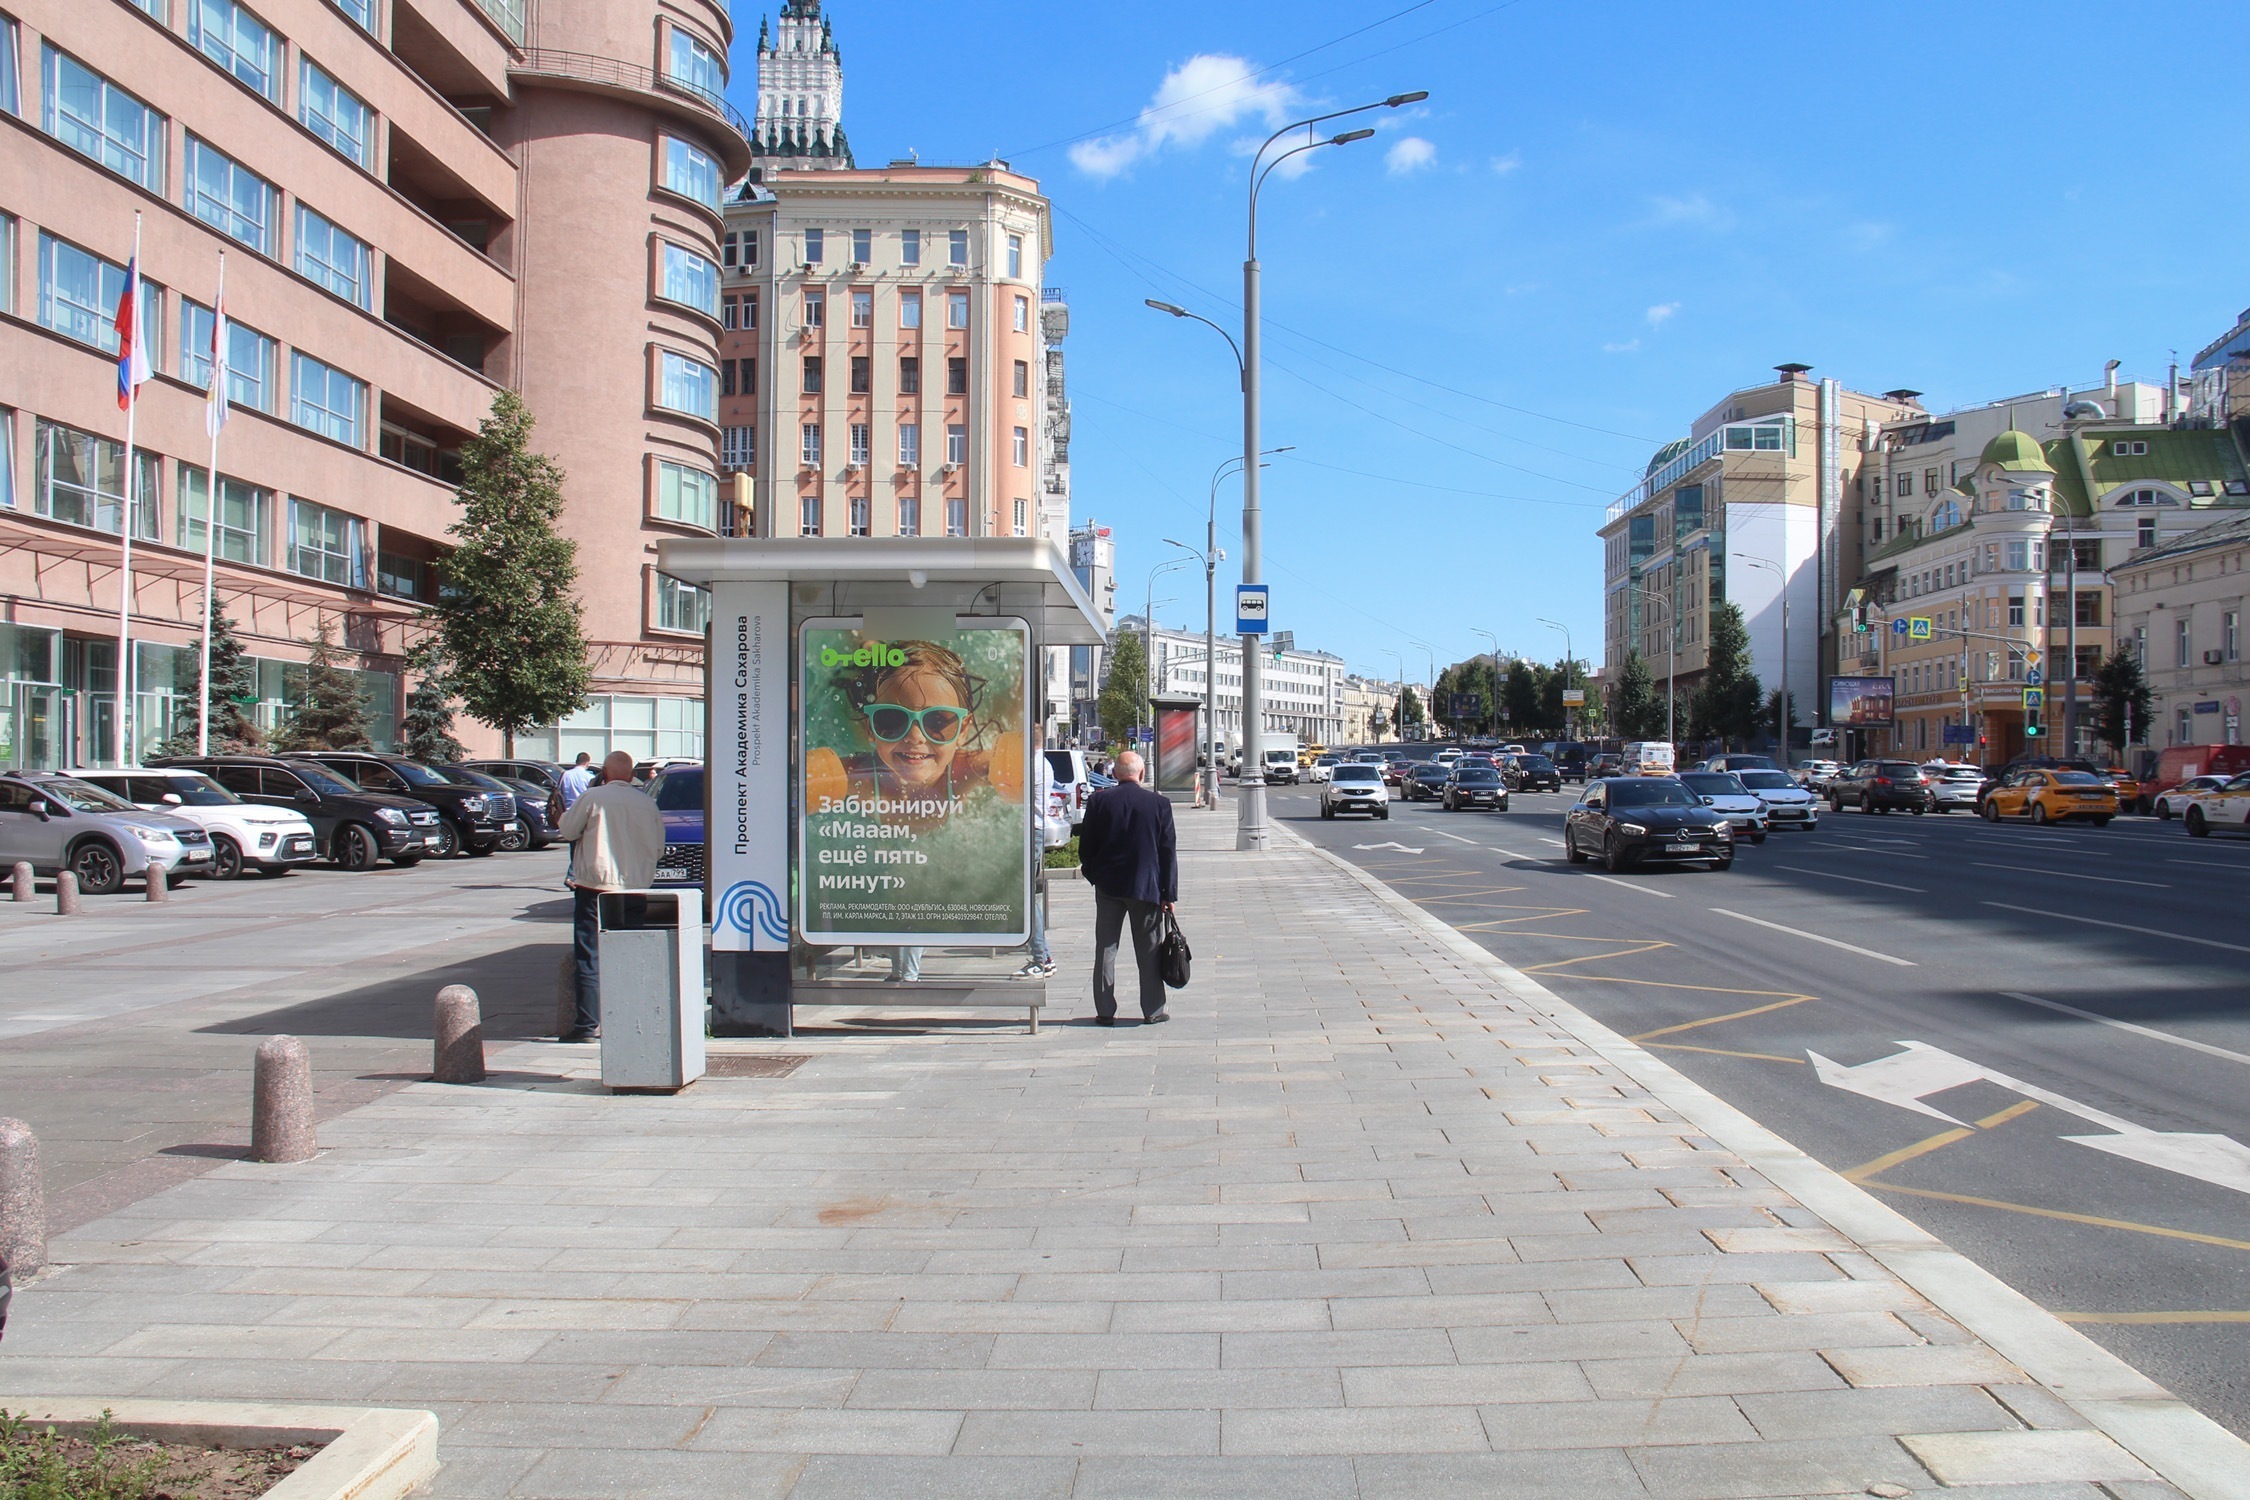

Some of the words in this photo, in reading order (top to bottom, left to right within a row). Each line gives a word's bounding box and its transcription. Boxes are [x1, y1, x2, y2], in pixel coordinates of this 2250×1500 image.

[735, 616, 750, 688] Сахарова
[752, 615, 761, 665] Sakharova
[752, 667, 761, 722] Akademika
[735, 692, 749, 778] Академика
[752, 723, 762, 766] Prospekt
[735, 782, 750, 855] Проспект
[818, 794, 964, 818] Забронируй
[818, 820, 918, 842] «Мааам,
[818, 844, 868, 866] ещё
[874, 849, 928, 865] пять
[818, 875, 906, 894] минут»
[848, 903, 896, 911] РЕКЛАМОДАТЕЛЬ:
[969, 904, 1012, 912] НОВОСИБИРСК,
